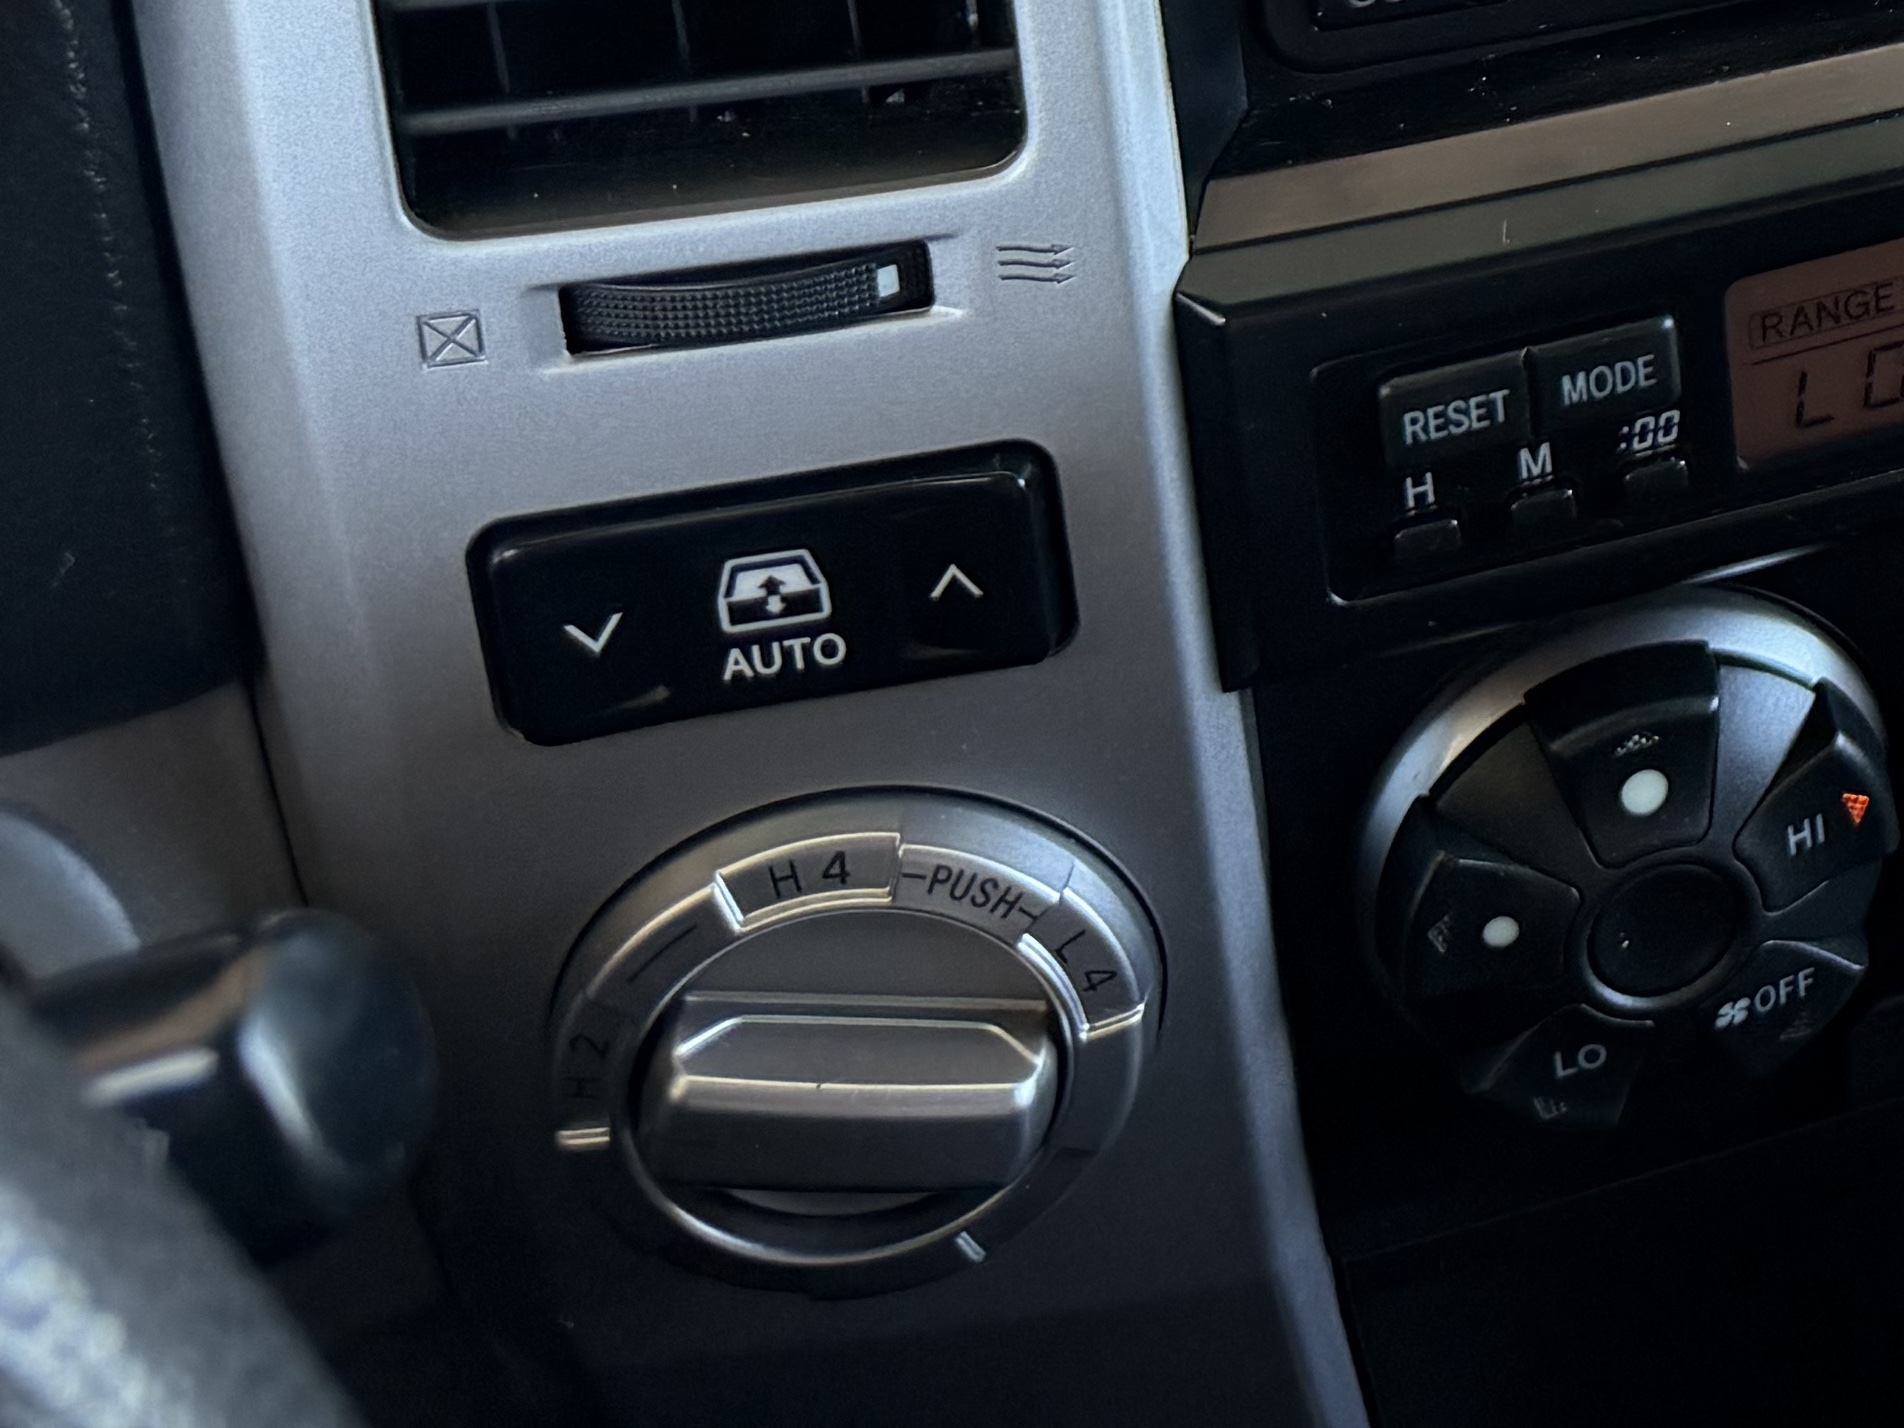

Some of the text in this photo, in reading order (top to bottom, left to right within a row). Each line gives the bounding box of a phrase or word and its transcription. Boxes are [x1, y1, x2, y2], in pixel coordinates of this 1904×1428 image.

[1760, 284, 1896, 342] RANGE
[1560, 354, 1656, 407] MODE
[1402, 390, 1510, 445] RESET
[1519, 444, 1551, 478] M
[1404, 473, 1434, 508] H
[723, 631, 848, 682] AUTO
[1786, 813, 1823, 854] HI
[1754, 967, 1816, 1016] OFF
[1553, 1044, 1606, 1078] LO
